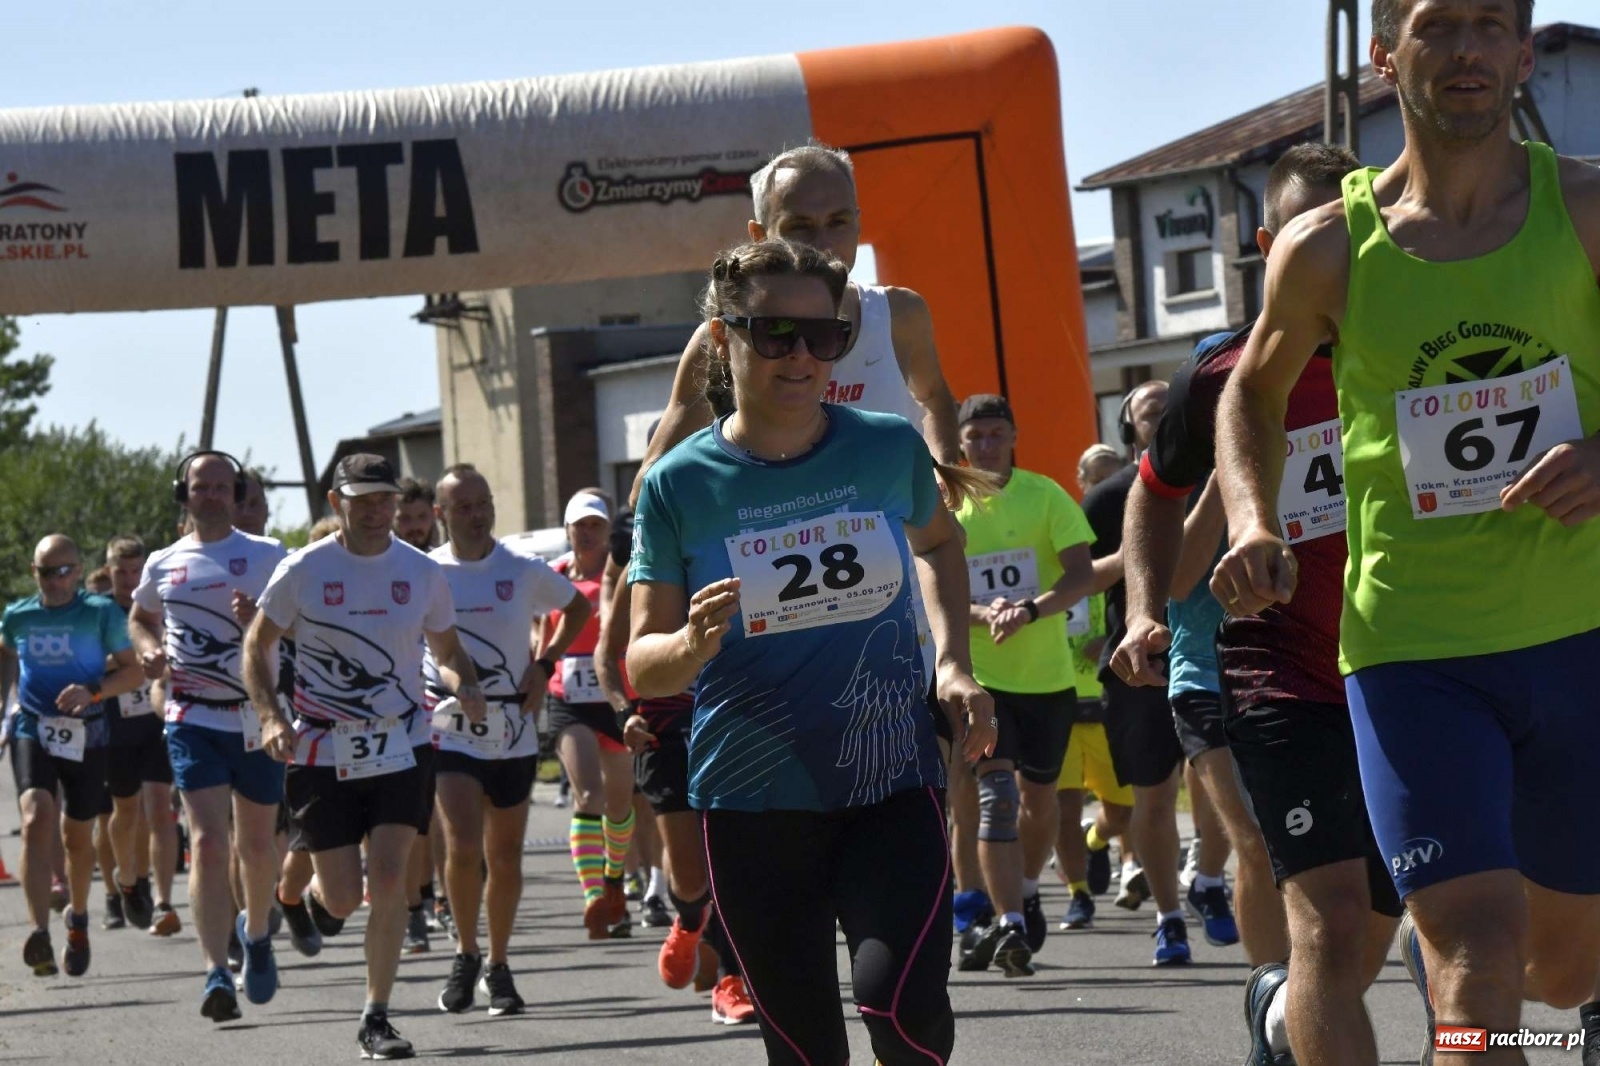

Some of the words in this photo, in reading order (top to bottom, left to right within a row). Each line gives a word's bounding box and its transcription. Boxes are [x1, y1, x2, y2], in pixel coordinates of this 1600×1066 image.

[174, 138, 480, 269] META
[1407, 356, 1429, 389] ALNY
[1458, 320, 1532, 347] GODZINNY
[1410, 386, 1508, 418] COLOUR
[1520, 369, 1560, 402] RUN
[1444, 405, 1540, 471] 67
[1303, 452, 1345, 497] 4
[1415, 480, 1449, 491] 10km,
[737, 484, 859, 520] BiegamBoLubię
[1283, 509, 1310, 521] 10km,
[1312, 499, 1347, 513] Krzano
[740, 525, 827, 557] COLOUR
[836, 517, 877, 538] RUN
[772, 543, 865, 602] 28
[981, 565, 1020, 590] 10
[748, 608, 779, 620] 10km,
[782, 595, 841, 613] Krzanowice,
[846, 580, 899, 599] 05.09.2021
[572, 669, 600, 688] 13
[44, 726, 73, 745] 29
[451, 713, 489, 737] 16
[351, 732, 388, 760] 37
